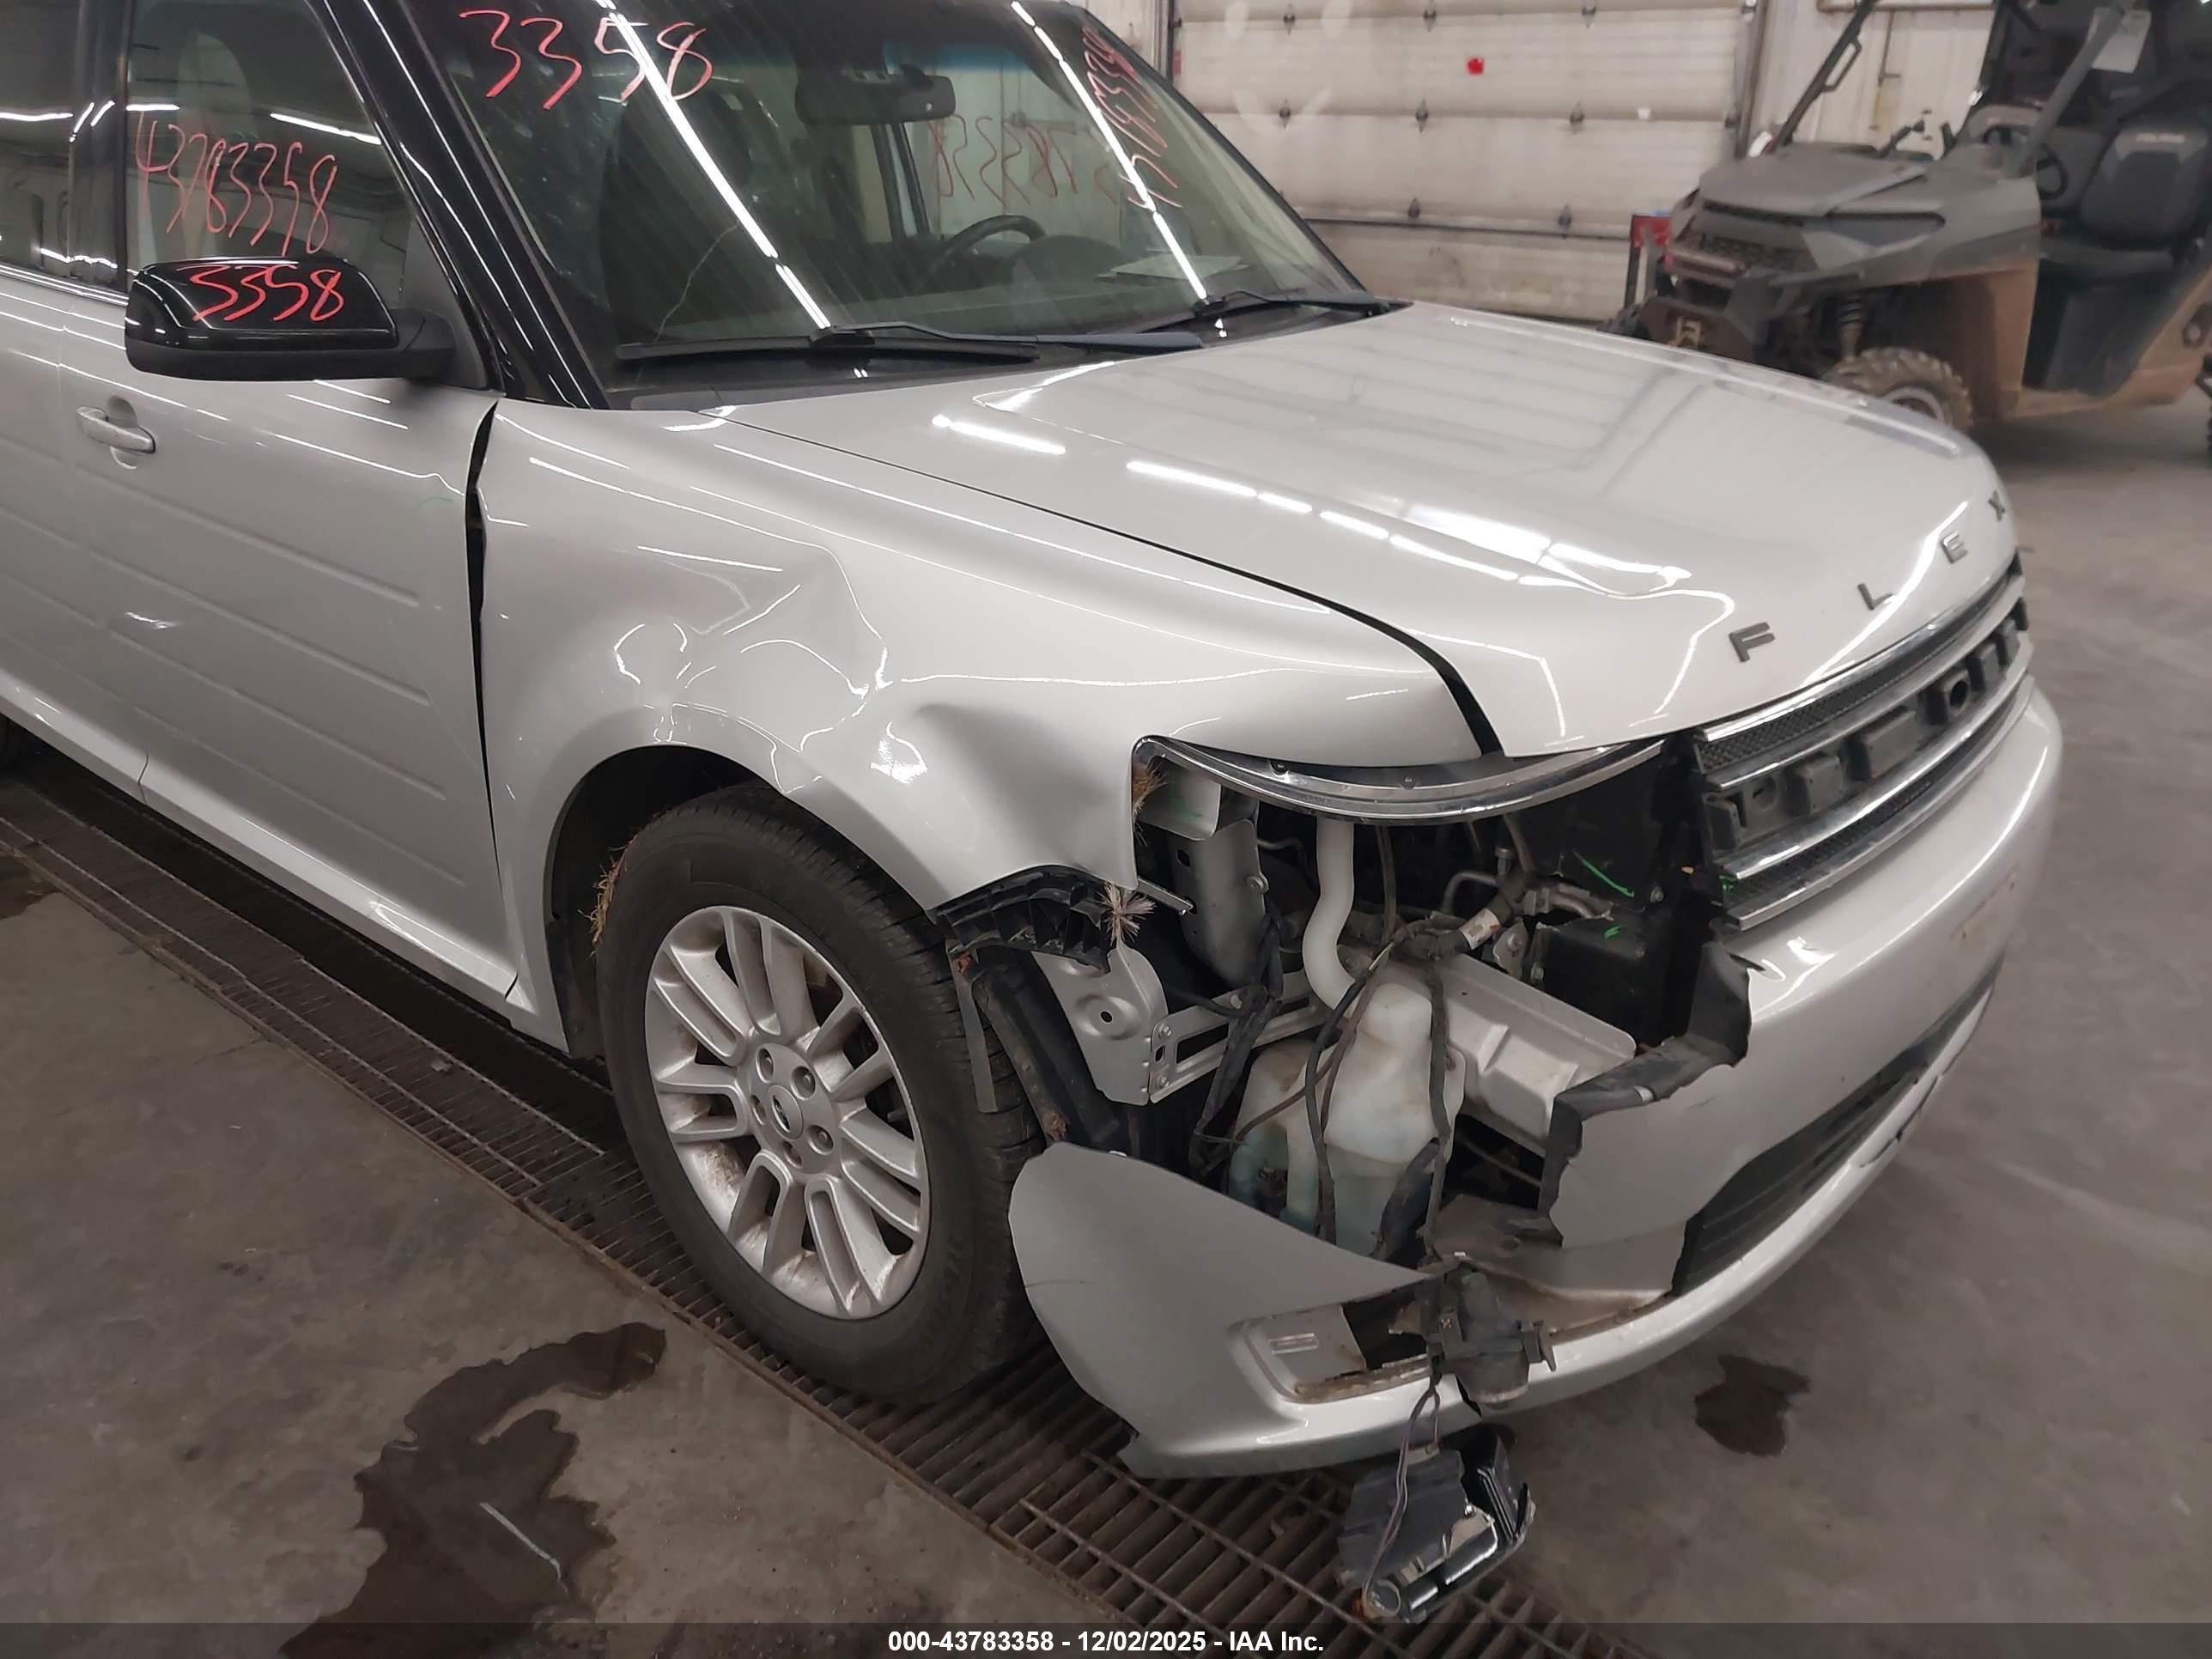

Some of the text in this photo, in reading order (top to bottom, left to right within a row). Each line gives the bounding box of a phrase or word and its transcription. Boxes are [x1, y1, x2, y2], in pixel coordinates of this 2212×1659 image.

[459, 9, 713, 111] 3358
[135, 108, 338, 258] 43783358
[175, 264, 345, 323] 3358
[1728, 489, 2006, 664] FLEX
